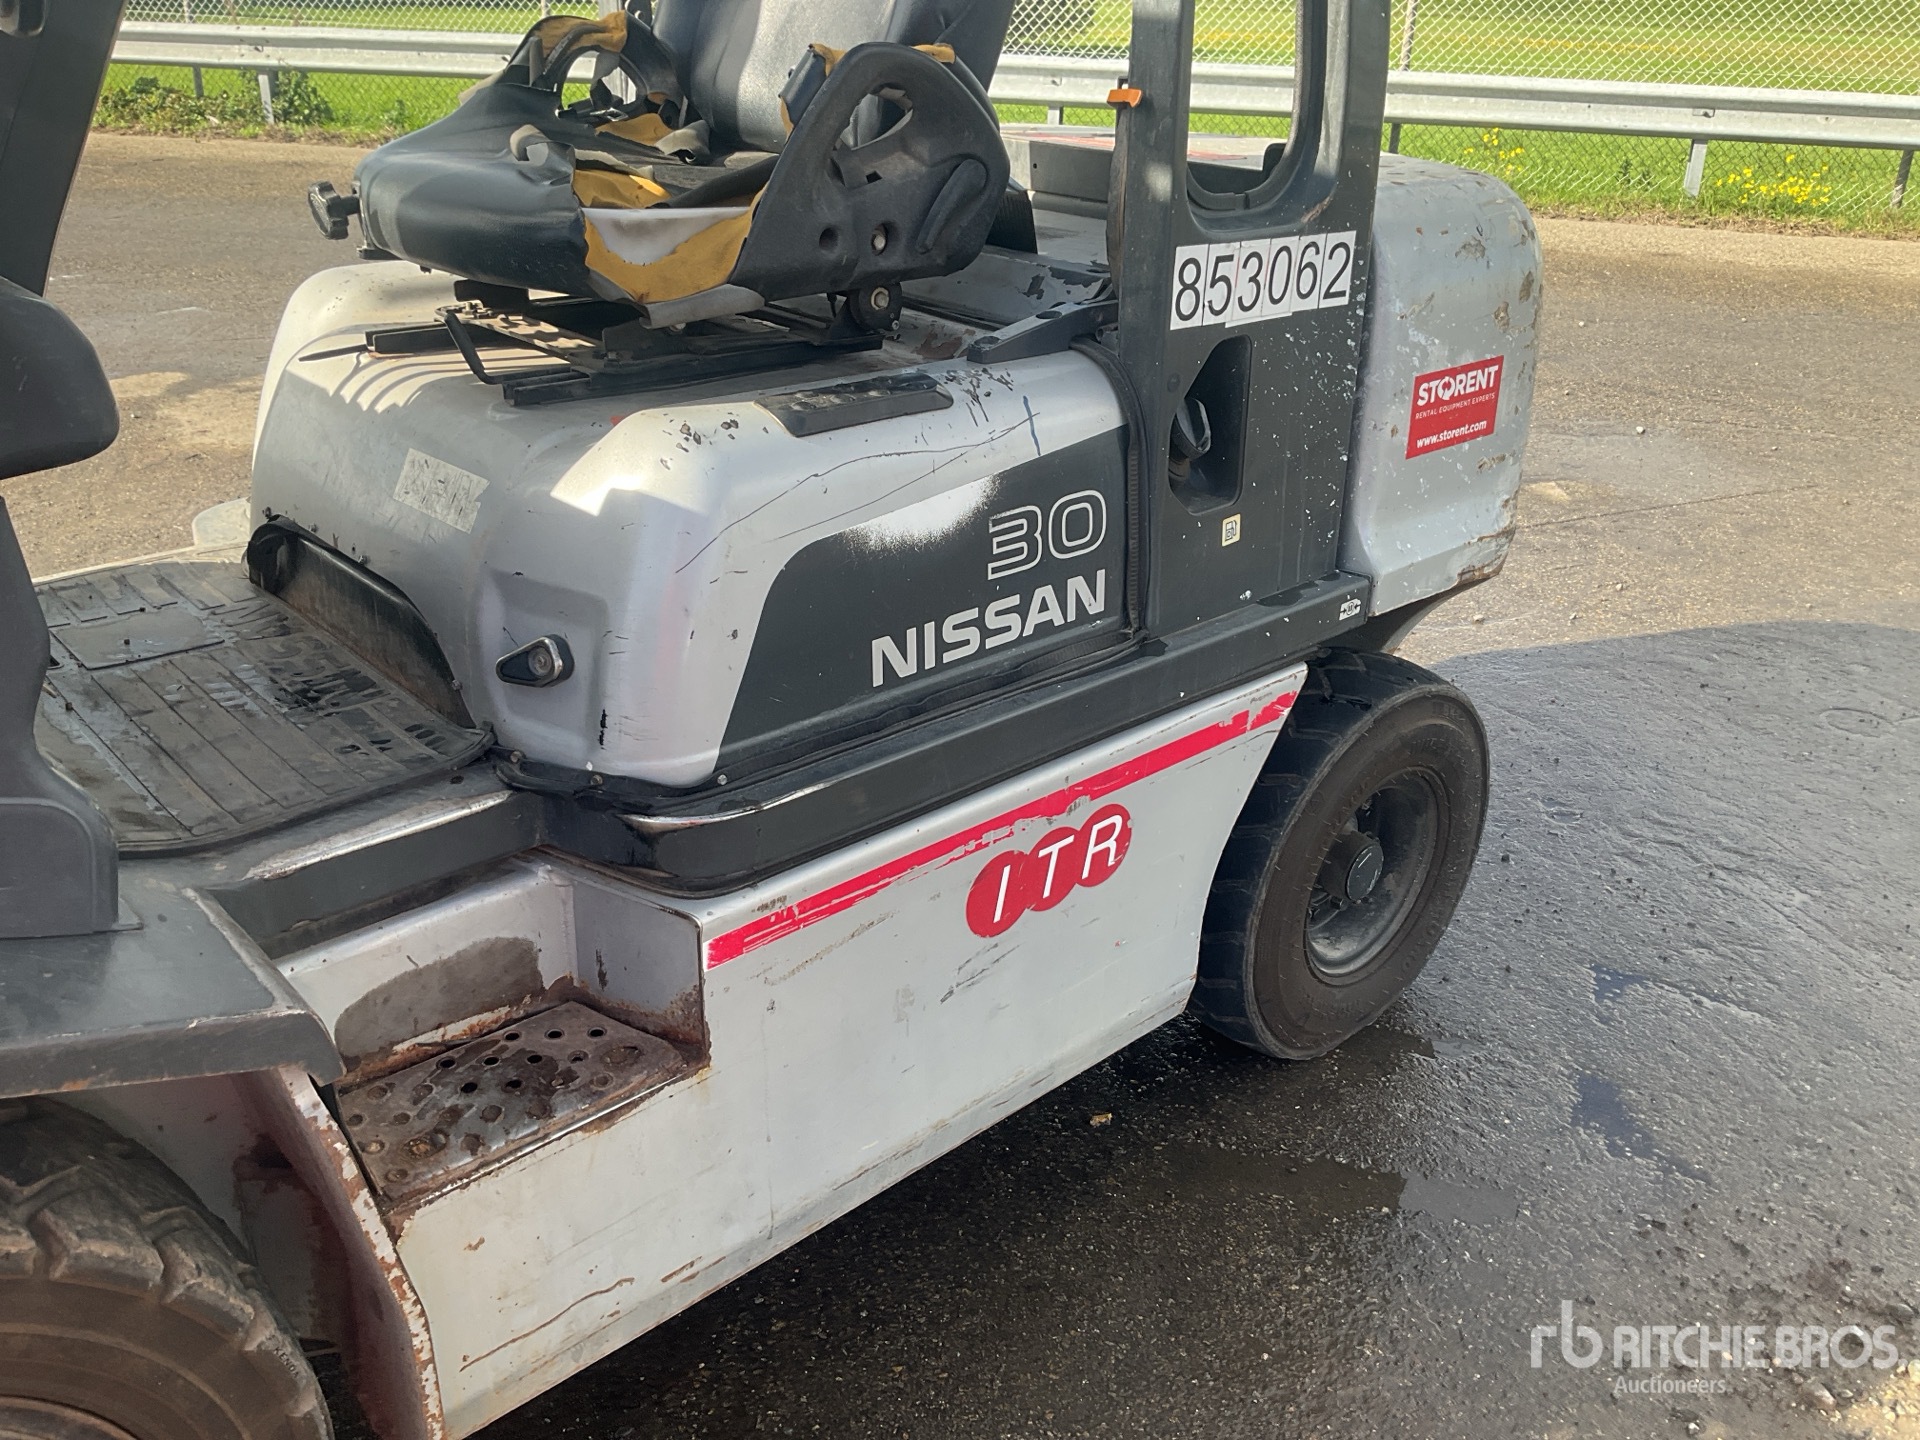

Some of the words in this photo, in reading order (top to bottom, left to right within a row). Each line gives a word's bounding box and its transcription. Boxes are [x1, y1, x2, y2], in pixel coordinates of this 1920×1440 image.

[1175, 241, 1351, 322] 853062
[1415, 408, 1438, 420] RENTAL
[1438, 398, 1472, 414] EQUIPMENT
[1471, 392, 1496, 405] EXPERTS
[1416, 364, 1499, 407] STORENT
[1416, 420, 1488, 448] www.storent.com
[987, 489, 1107, 580] 30
[872, 568, 1106, 688] NISSAN
